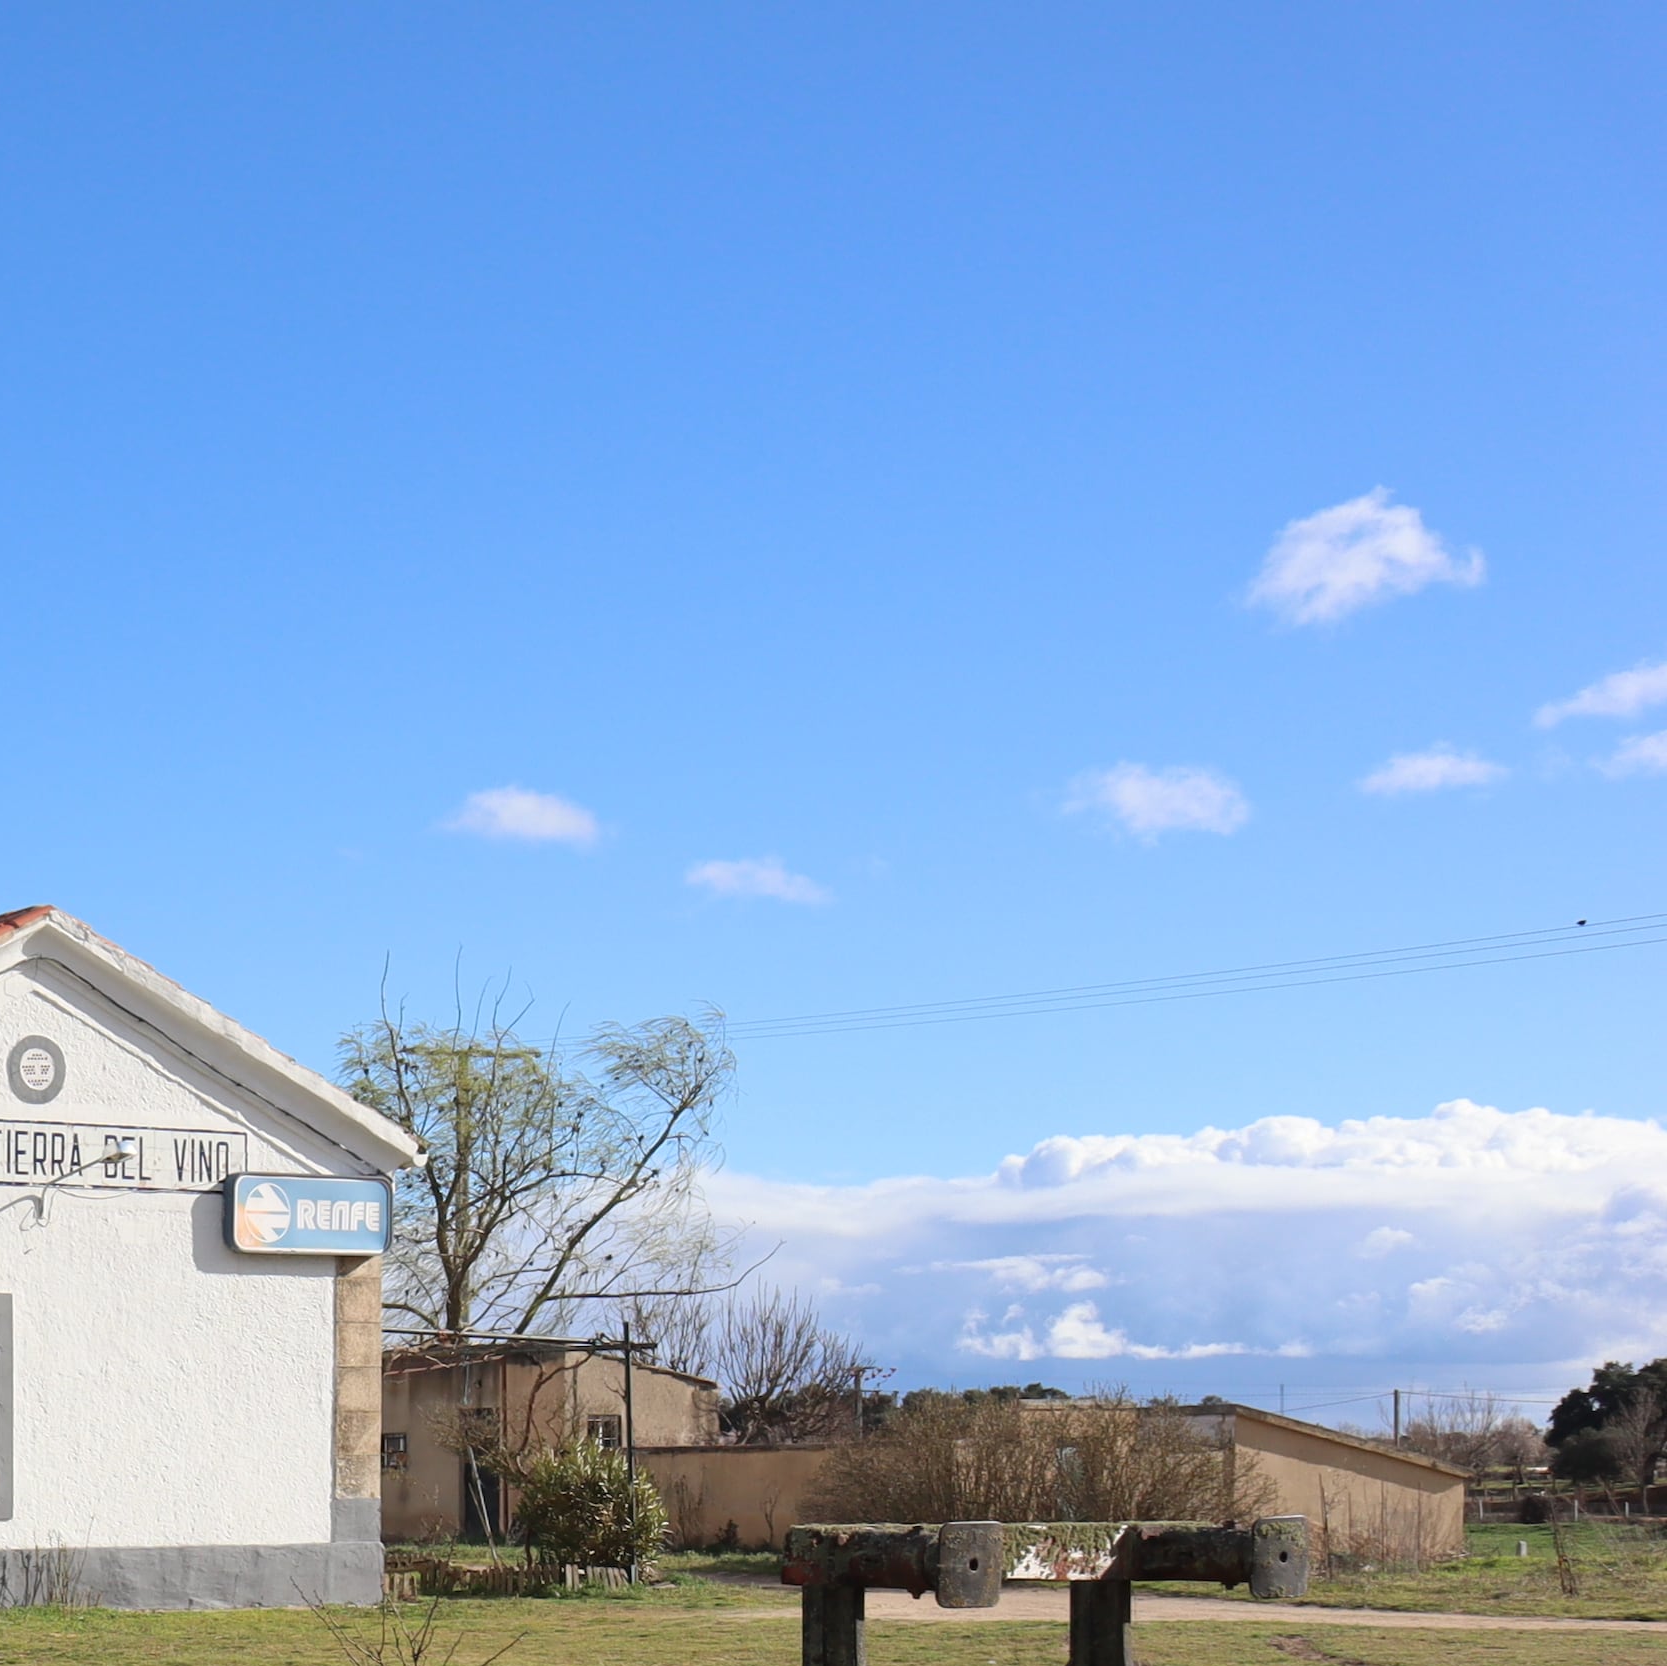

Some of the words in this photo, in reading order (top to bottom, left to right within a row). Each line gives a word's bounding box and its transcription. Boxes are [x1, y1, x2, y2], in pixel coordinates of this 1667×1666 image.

[104, 1134, 152, 1181] DEL
[174, 1137, 230, 1183] VINO
[296, 1199, 380, 1232] RENFE
